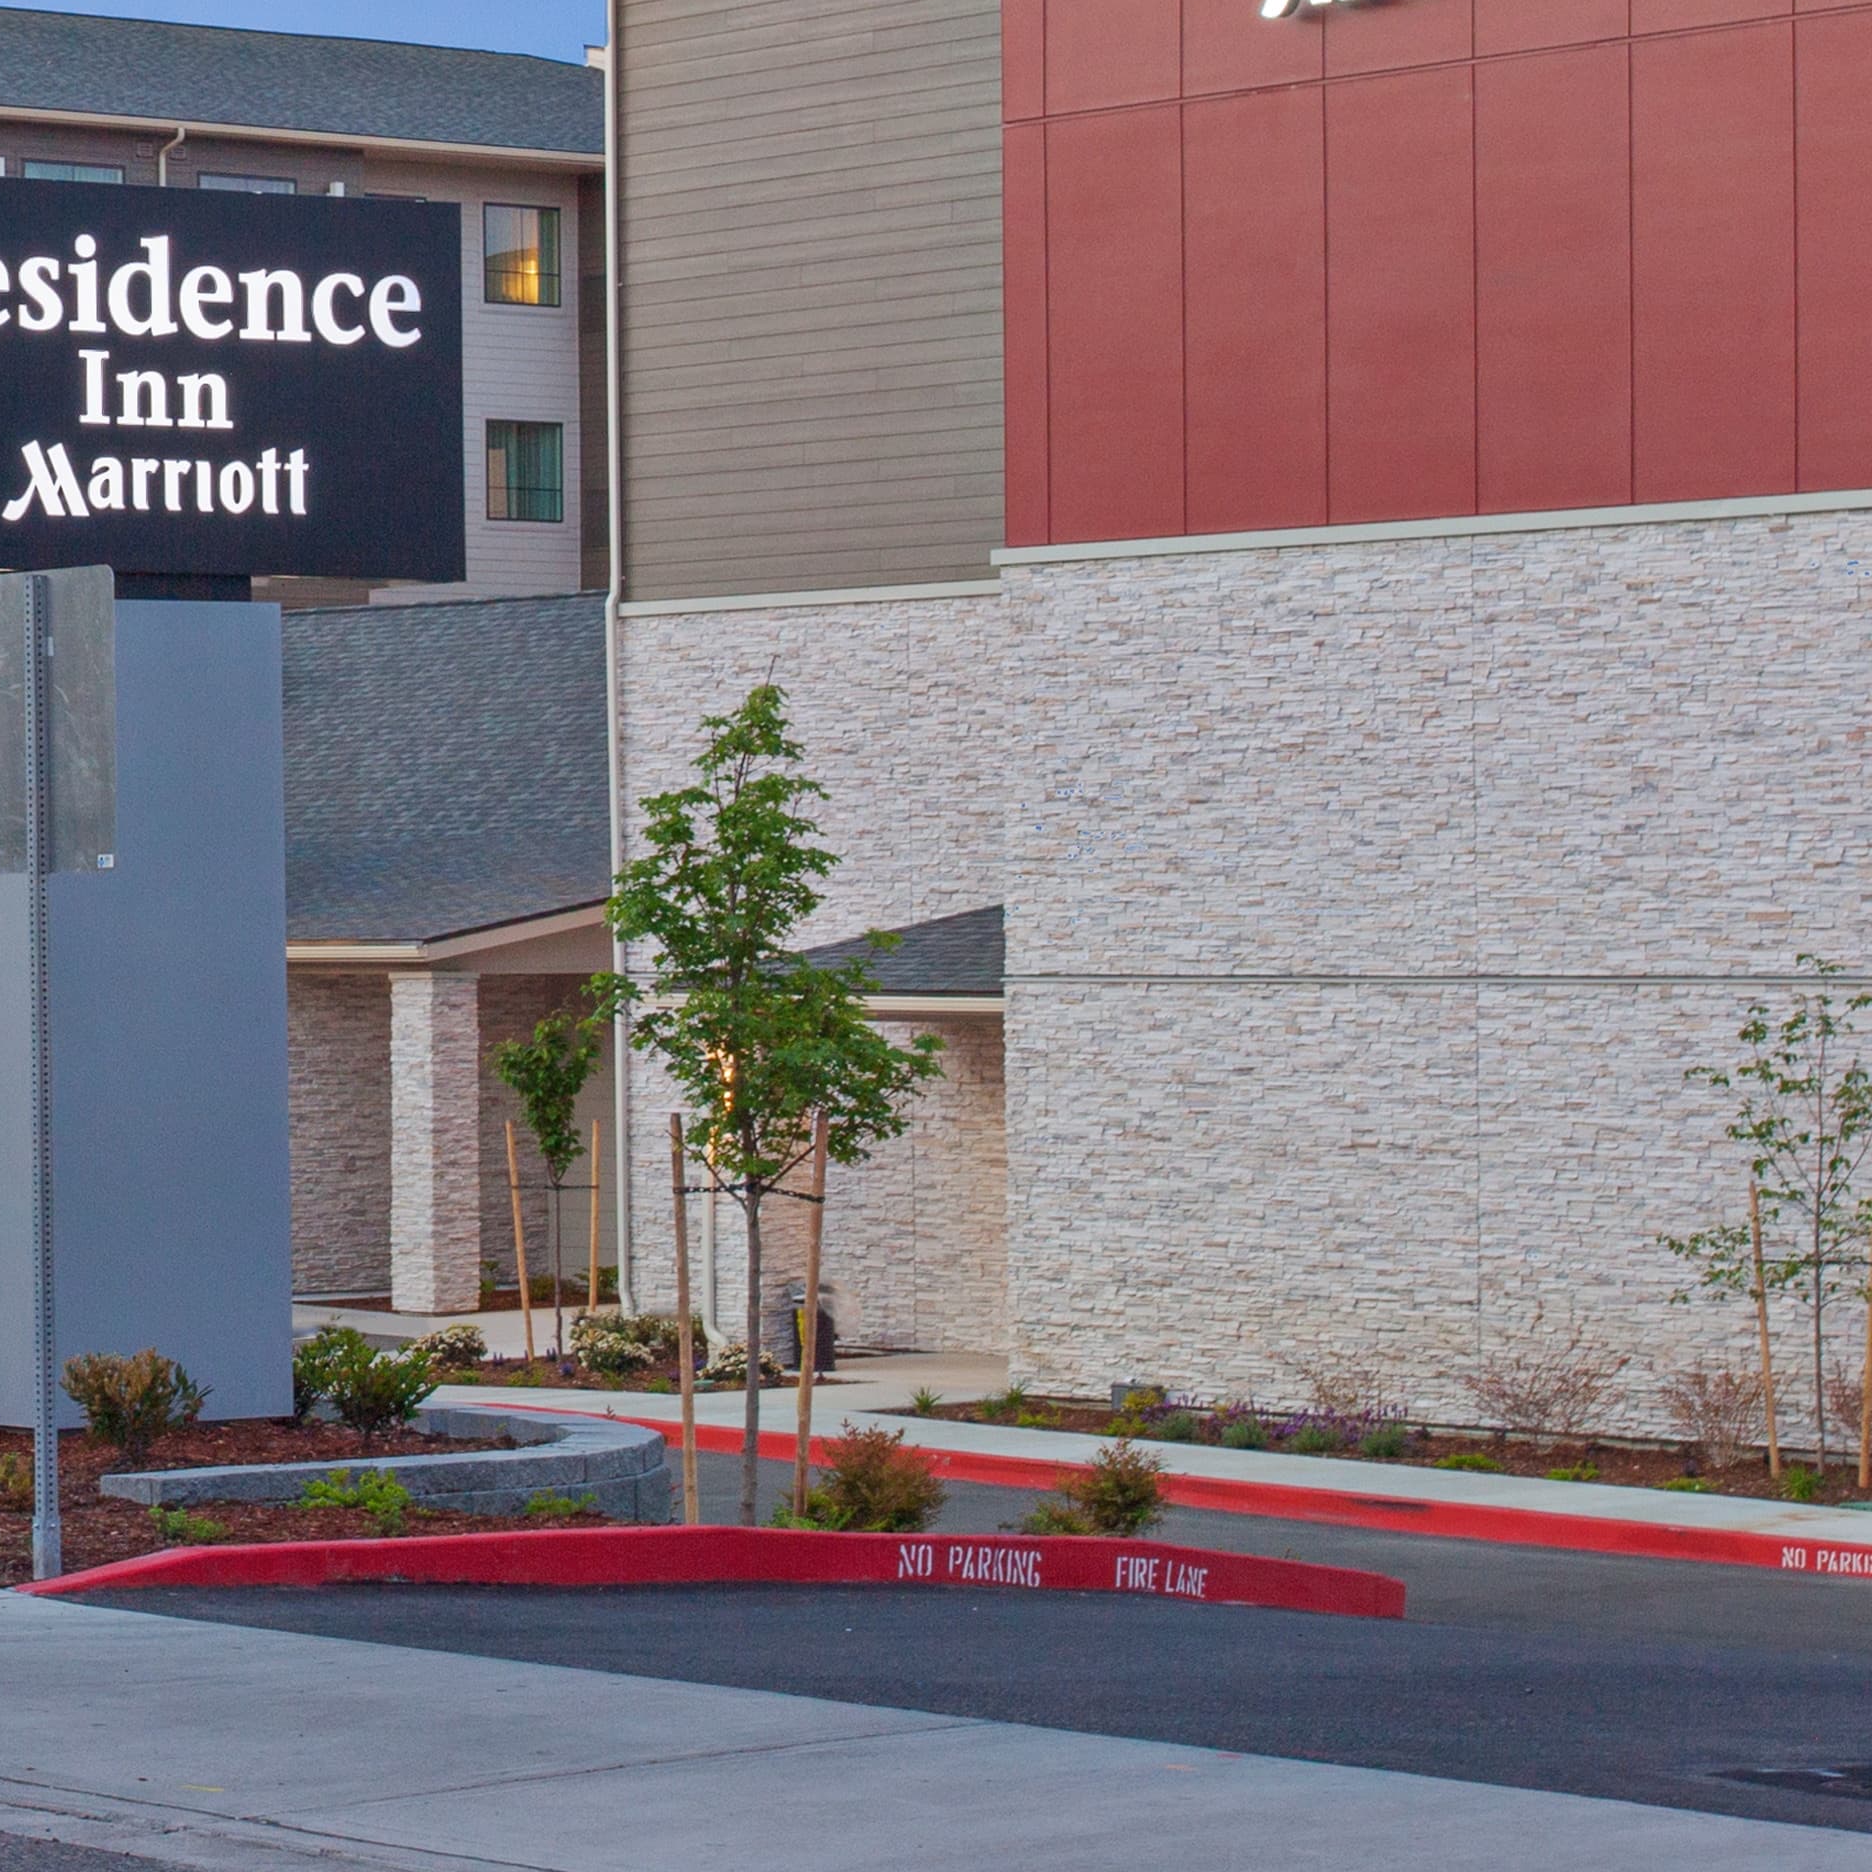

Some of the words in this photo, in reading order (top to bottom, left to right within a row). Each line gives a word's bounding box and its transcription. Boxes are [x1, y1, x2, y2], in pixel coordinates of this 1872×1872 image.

[78, 349, 234, 429] Inn
[1, 439, 310, 521] Marriott
[898, 1544, 933, 1578] NO
[949, 1545, 1042, 1587] PARKING
[1115, 1556, 1160, 1592] FIRE
[1165, 1560, 1209, 1598] LANE
[1781, 1546, 1807, 1568] NO
